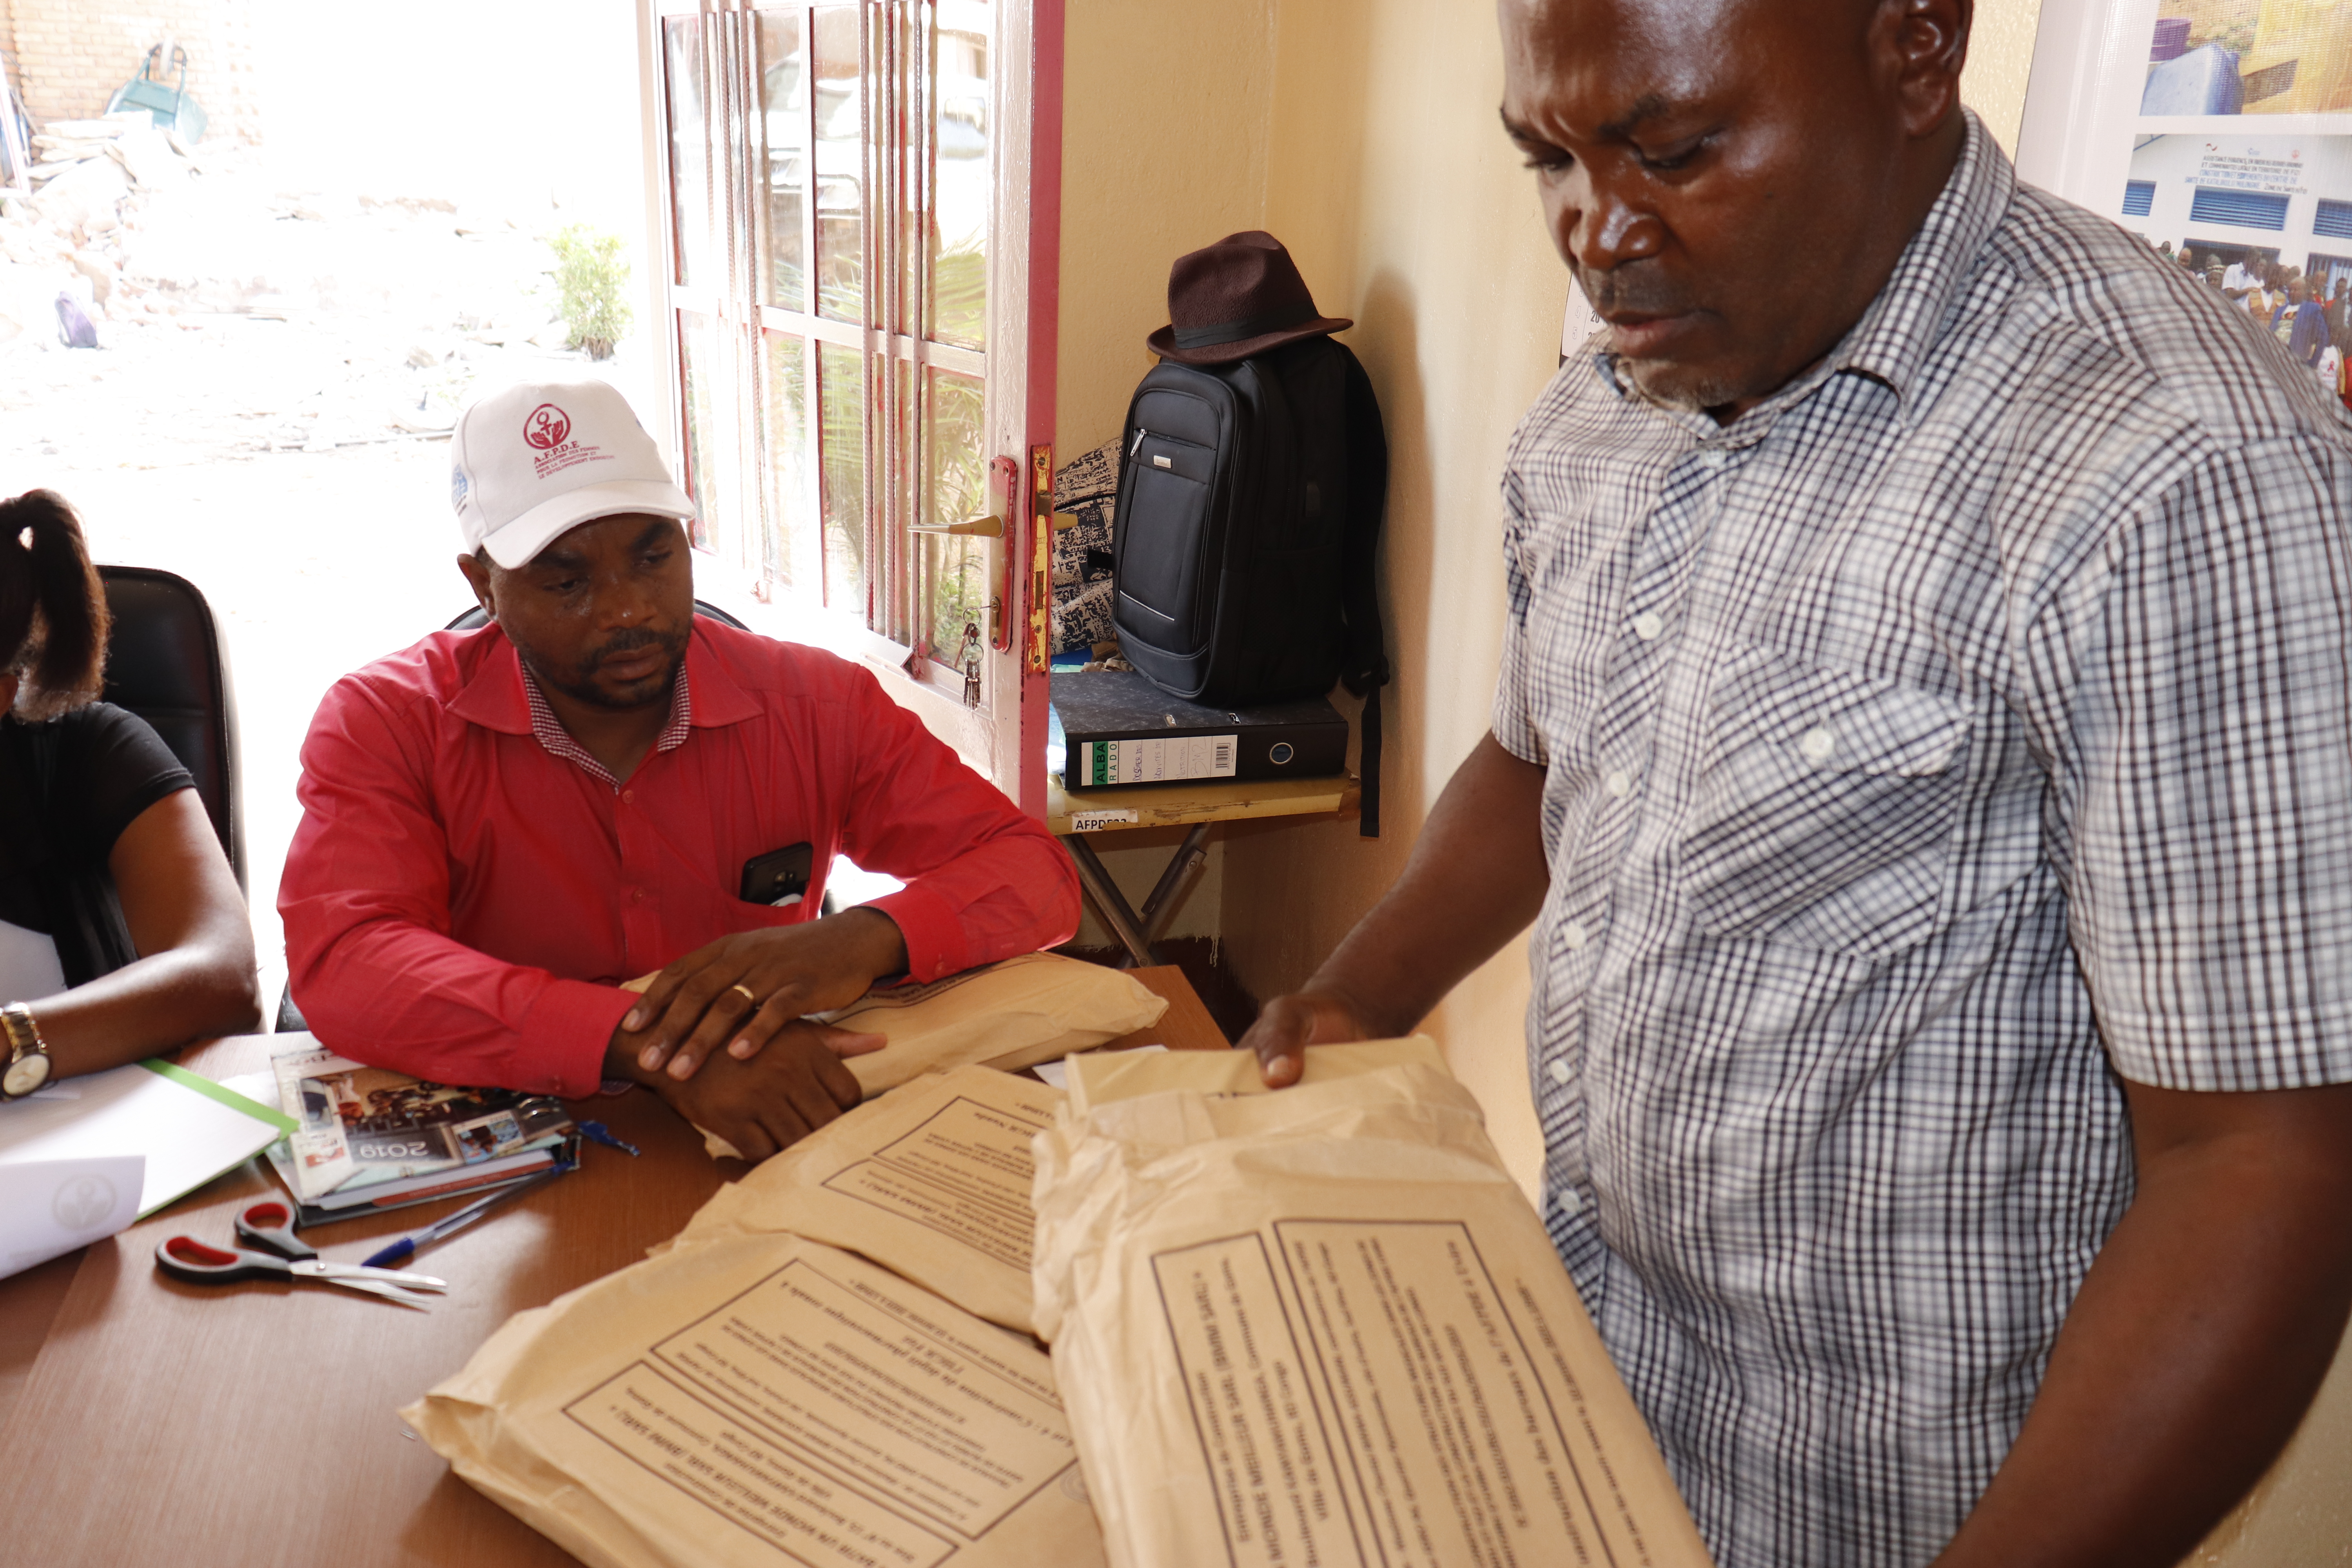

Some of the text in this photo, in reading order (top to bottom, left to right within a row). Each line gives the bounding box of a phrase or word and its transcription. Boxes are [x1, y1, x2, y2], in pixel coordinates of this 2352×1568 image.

[1575, 306, 1581, 318] 4
[1590, 310, 1600, 323] 20
[1572, 327, 1578, 339] 5
[534, 441, 579, 465] A.F.P.D.E
[1097, 743, 1105, 782] ALBA
[1076, 818, 1126, 830] AFPD
[361, 1142, 428, 1158] 2019
[1499, 1351, 1513, 1367] de
[941, 1374, 957, 1387] du
[958, 1385, 1033, 1428] Construction
[1508, 1370, 1539, 1434] bureaux
[1220, 1449, 1230, 1464] de
[1232, 1413, 1263, 1486] MEILLEUR
[1534, 1438, 1551, 1465] des
[1307, 1467, 1318, 1485] de
[723, 1499, 736, 1509] de
[1313, 1490, 1328, 1521] Ville
[1256, 1492, 1282, 1560] MONDE
[1546, 1470, 1594, 1568] onstruction
